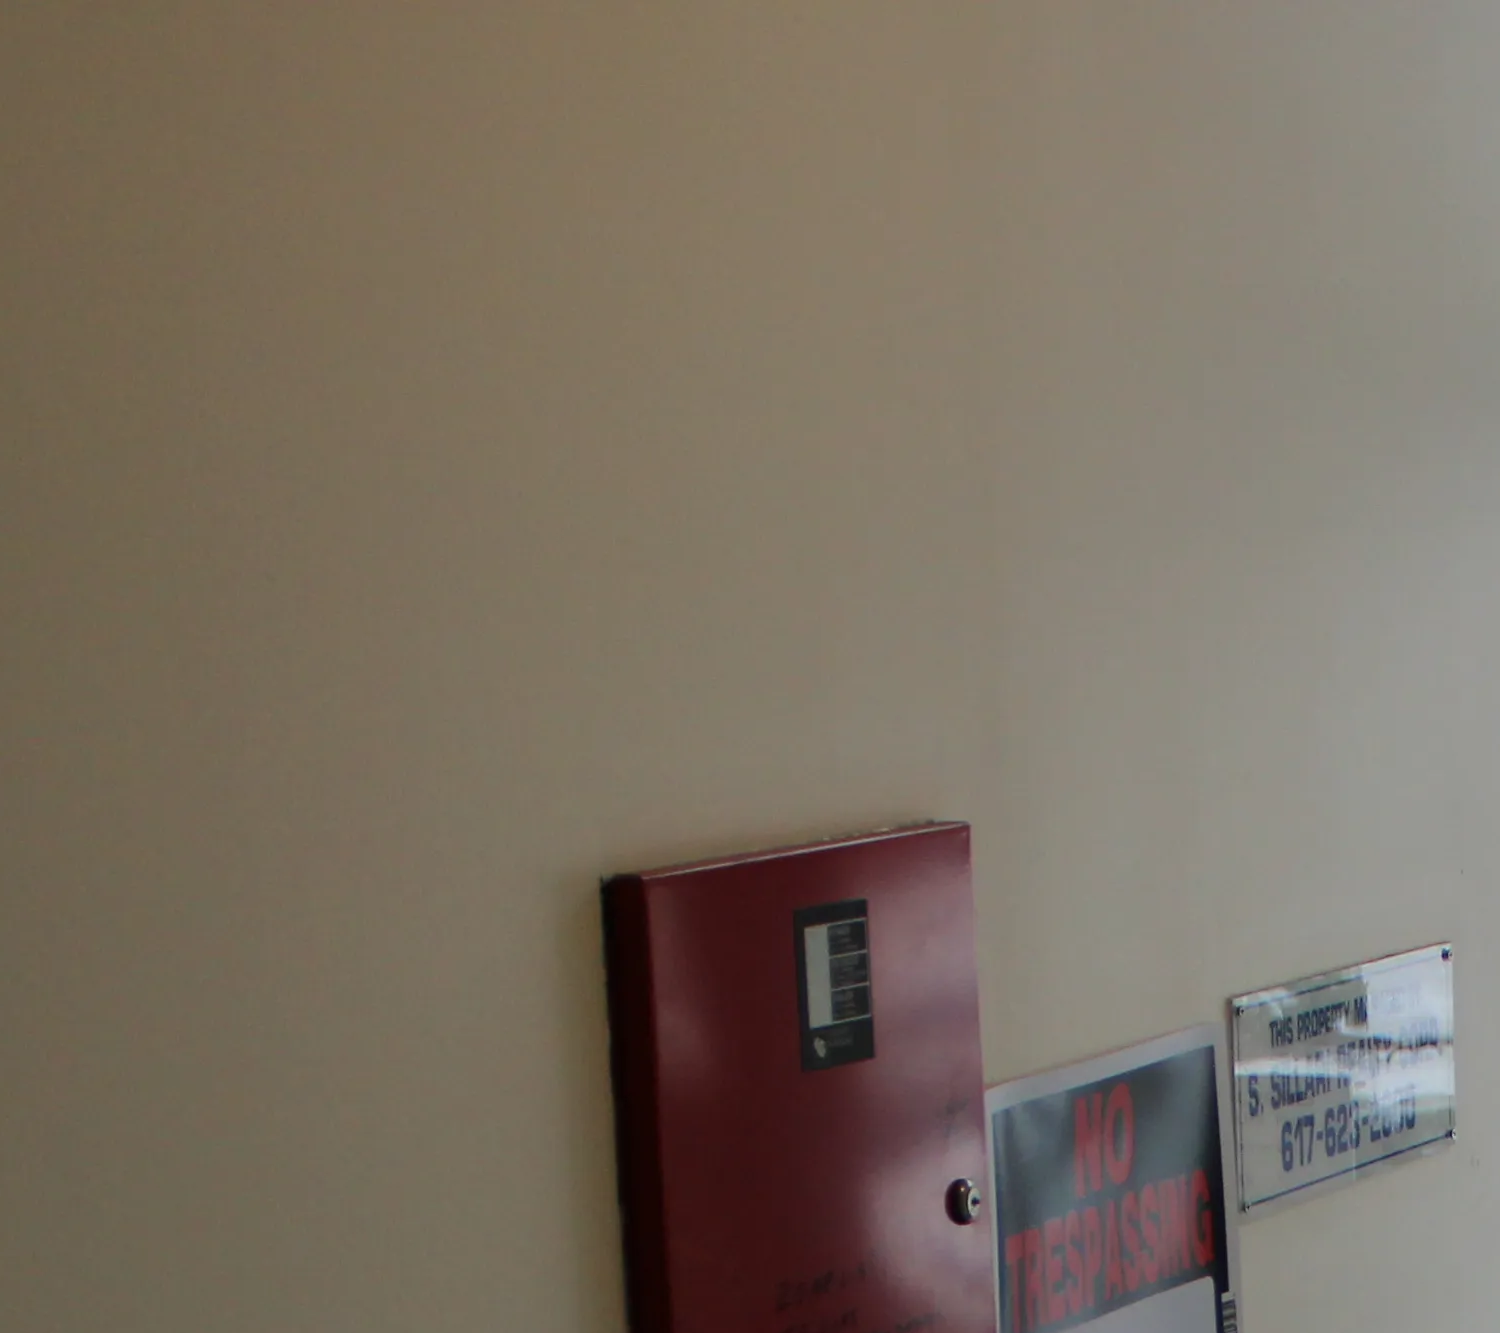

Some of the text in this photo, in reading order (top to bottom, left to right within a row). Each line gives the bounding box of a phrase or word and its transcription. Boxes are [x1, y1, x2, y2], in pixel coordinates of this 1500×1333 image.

[1269, 1015, 1293, 1048] THIS
[1296, 999, 1349, 1041] PROPERTY
[1073, 1082, 1135, 1196] NO
